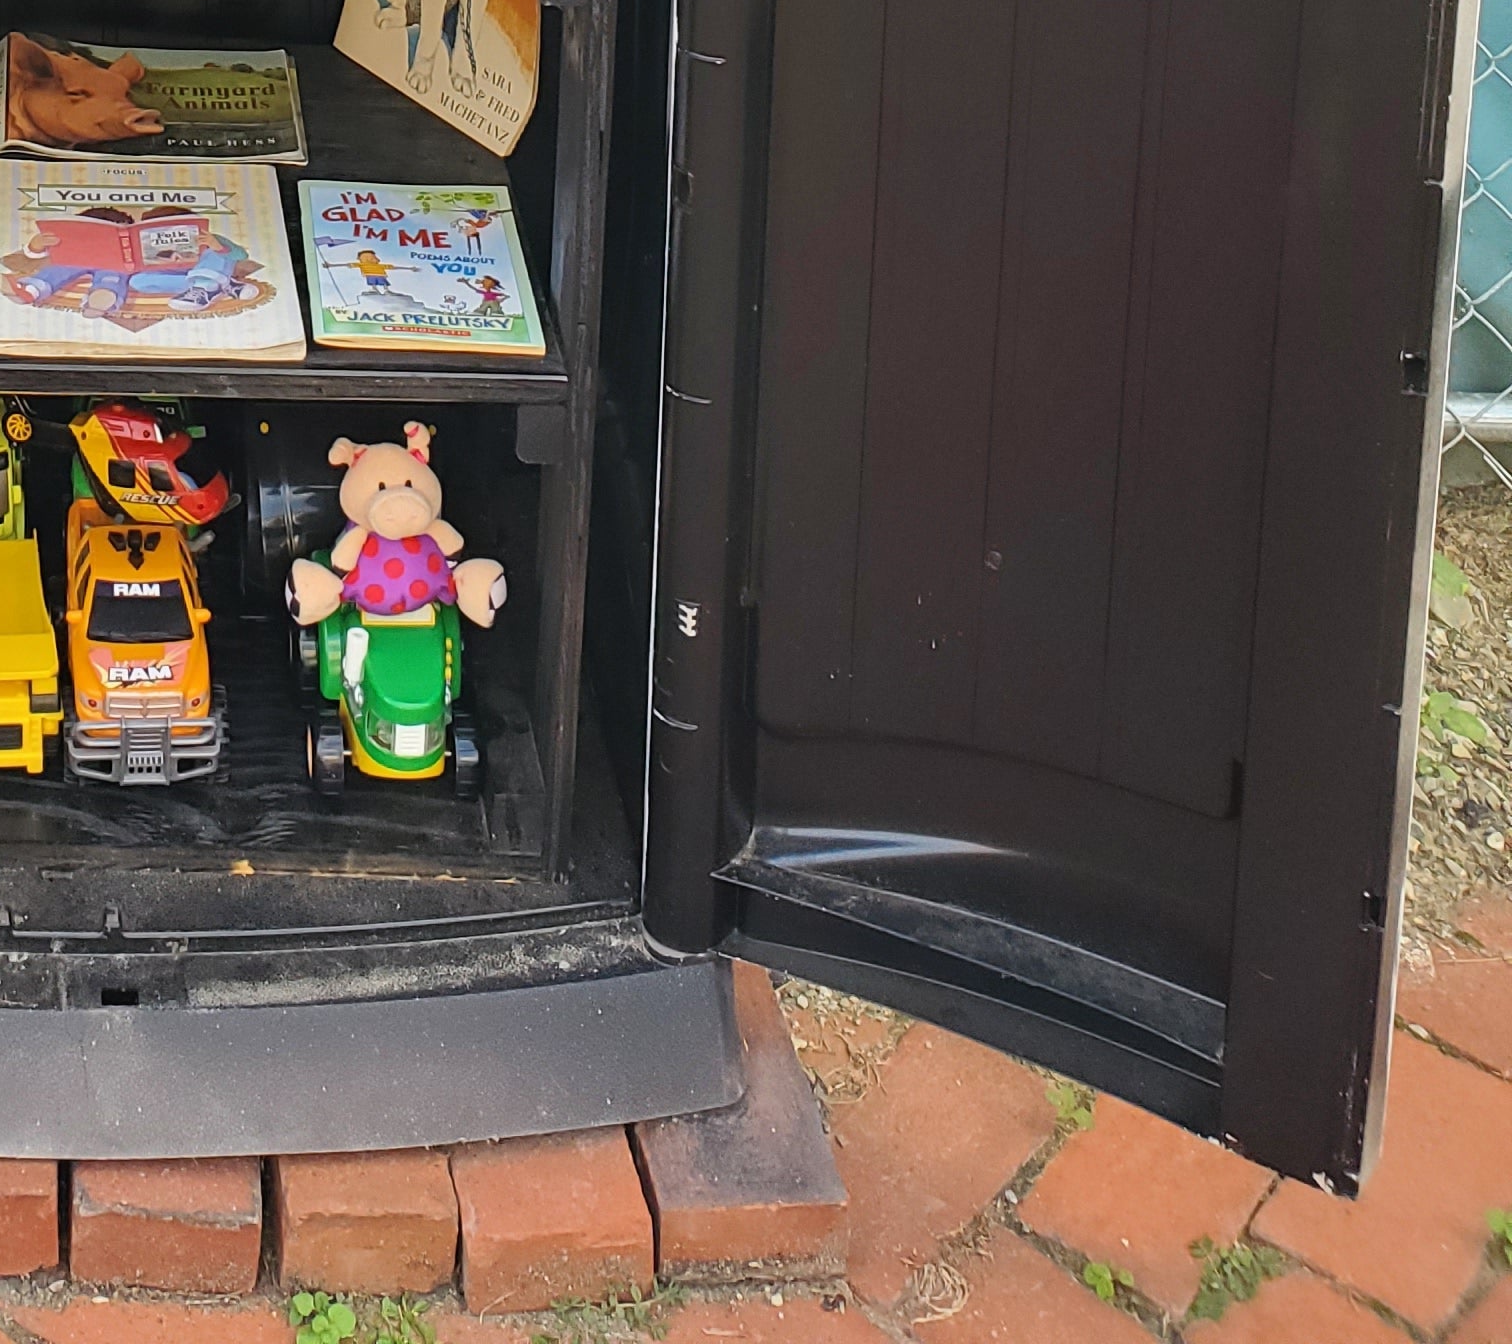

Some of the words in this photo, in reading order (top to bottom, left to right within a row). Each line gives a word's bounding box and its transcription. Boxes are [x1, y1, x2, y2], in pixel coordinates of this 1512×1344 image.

[481, 66, 513, 94] SARA
[145, 81, 277, 100] Farmyard
[165, 96, 271, 111] Animals
[487, 95, 521, 124] FRED
[438, 91, 510, 145] MACHETANZ
[167, 138, 216, 147] PAUL
[226, 137, 278, 146] HESS
[55, 189, 101, 203] You
[108, 189, 155, 203] and
[161, 192, 197, 204] Me
[340, 191, 378, 206] I'M
[321, 206, 405, 223] GLAD
[155, 230, 188, 239] Folk
[352, 223, 389, 242] I'M
[398, 228, 453, 249] ME
[409, 251, 451, 262] POEMS
[454, 254, 497, 266] ABOUT
[431, 262, 477, 277] YOU
[346, 311, 396, 324] JACK
[401, 312, 513, 330] PRELUTSKY
[121, 491, 179, 505] RESCUE
[113, 583, 160, 595] RAM
[108, 666, 171, 681] RAM
